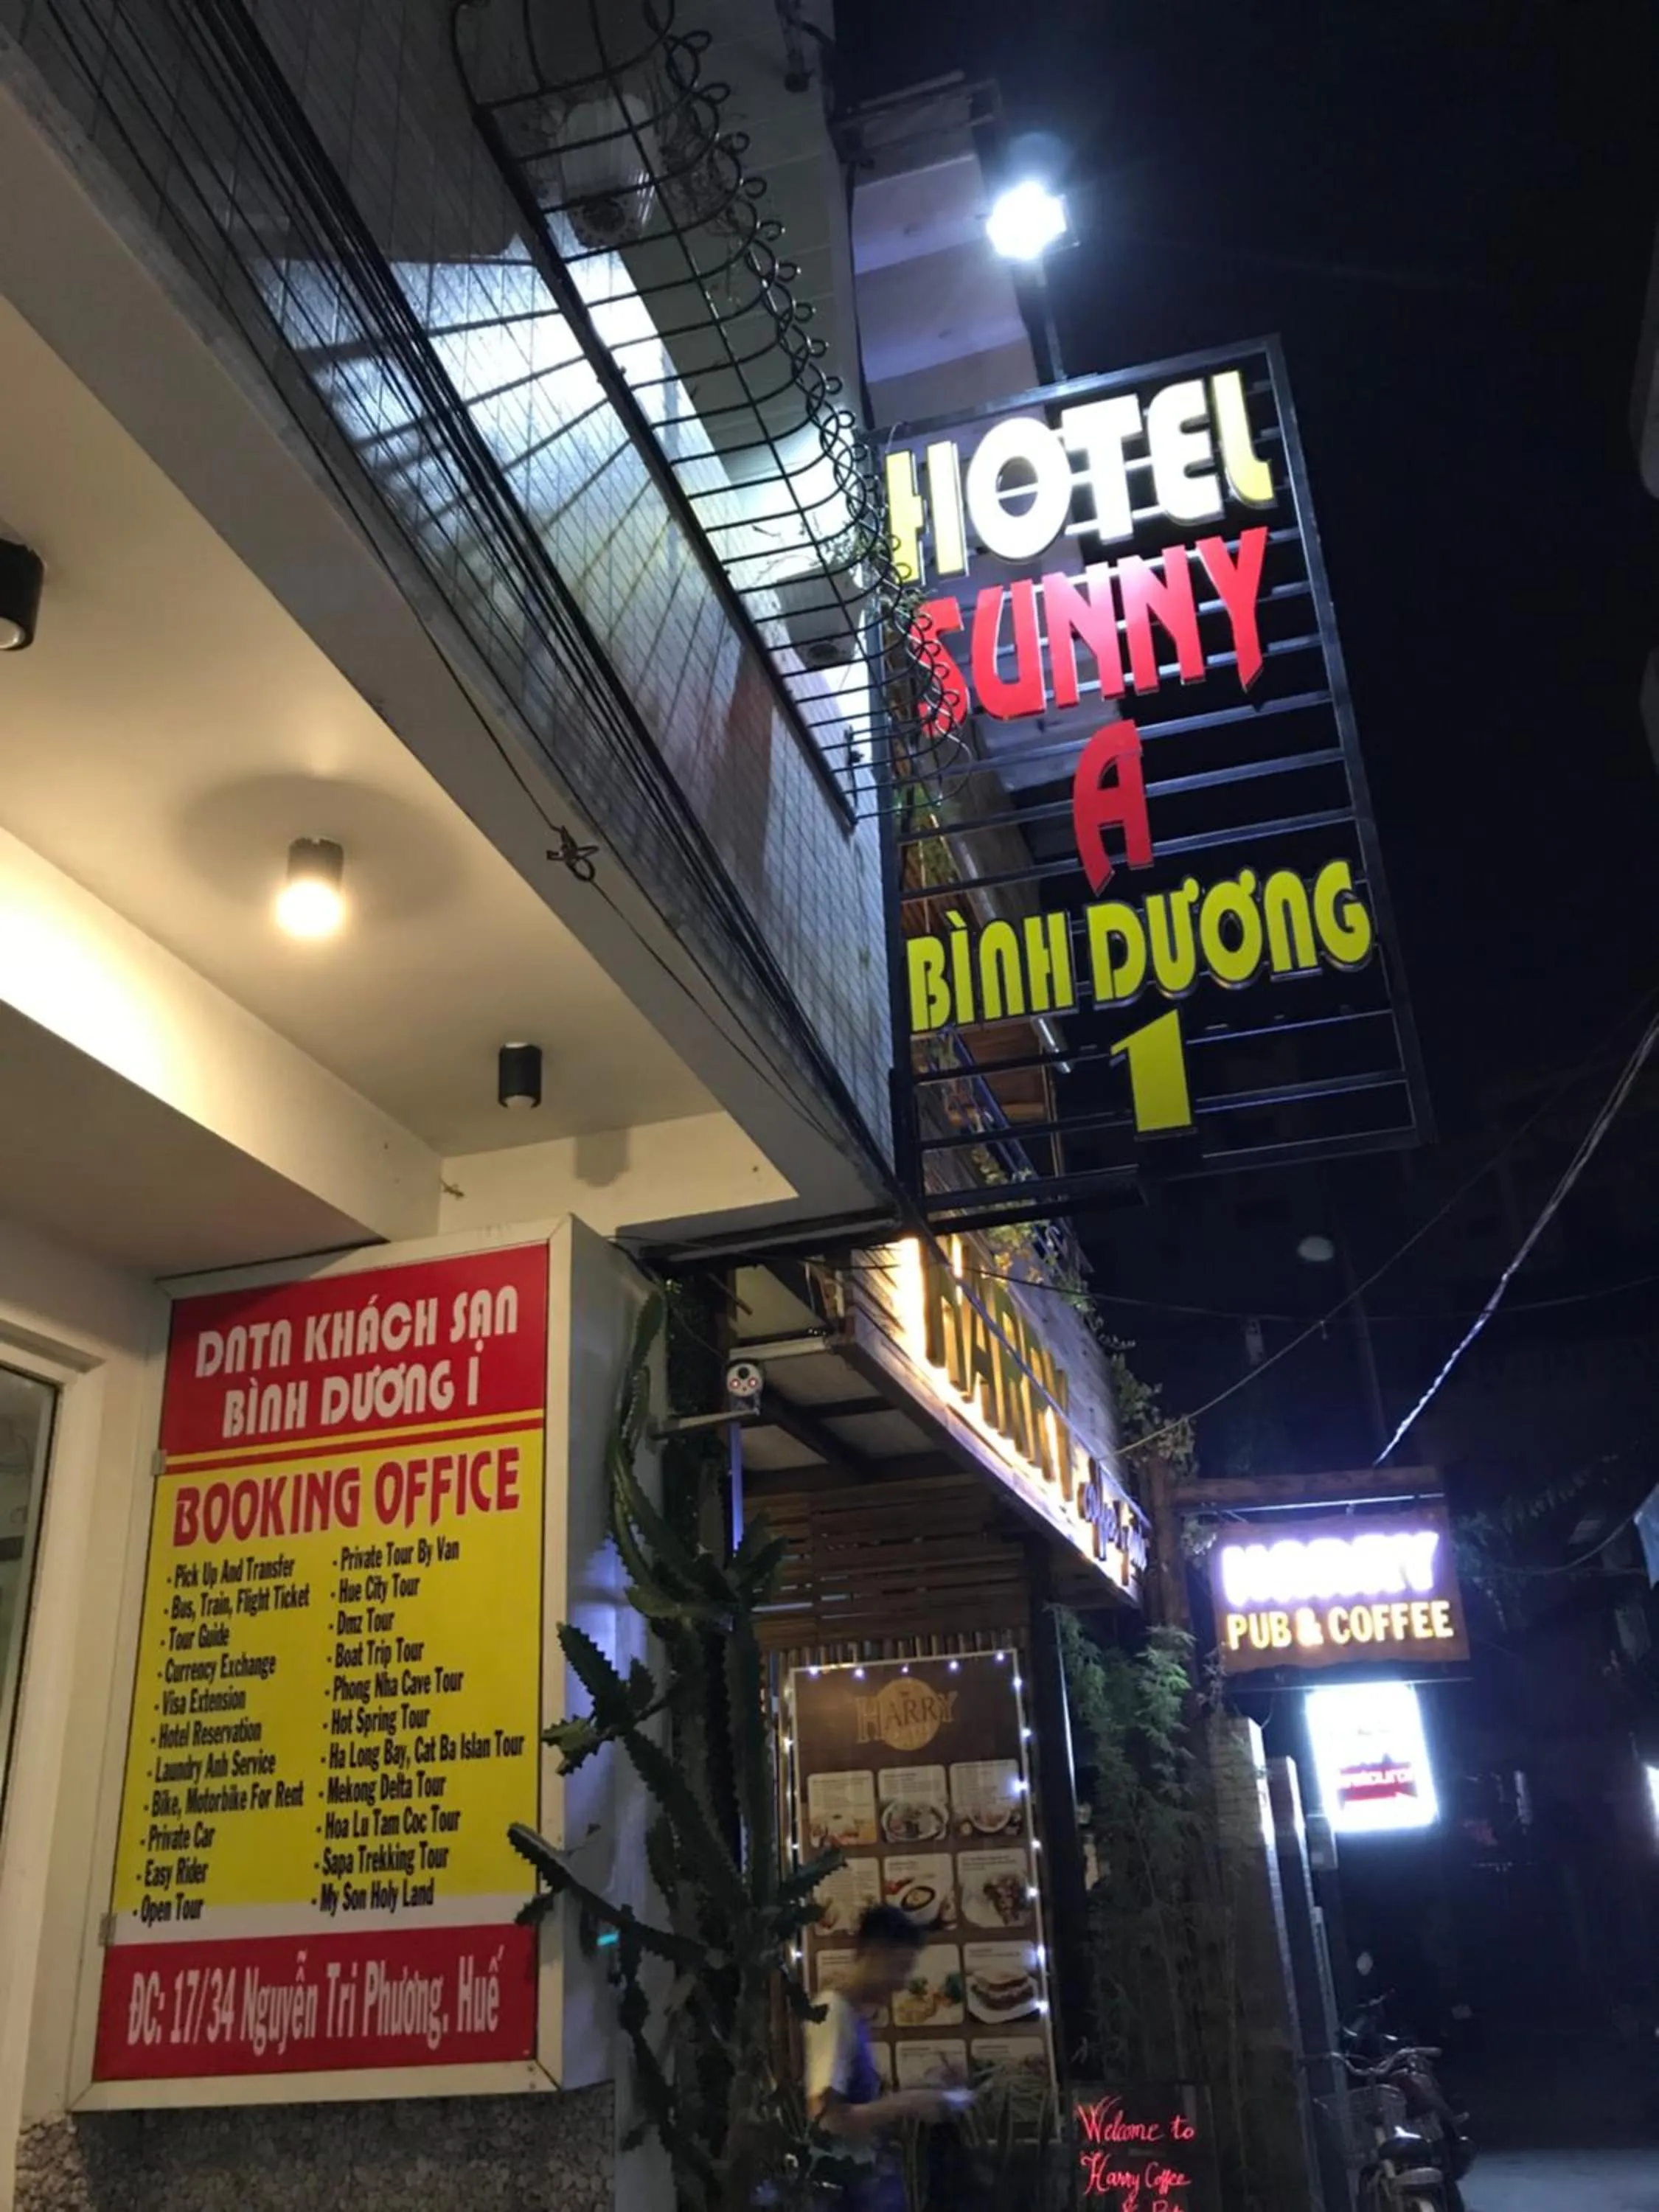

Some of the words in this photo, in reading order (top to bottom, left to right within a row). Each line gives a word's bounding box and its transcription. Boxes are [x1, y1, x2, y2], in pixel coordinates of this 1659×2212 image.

[885, 369, 1276, 585] HOTEL
[910, 526, 1269, 738] SUNNY
[1073, 719, 1153, 897] A
[906, 911, 1078, 1032] BÌNH
[1086, 860, 1373, 1006] DƯƠNG
[1110, 1008, 1194, 1135] 1
[304, 1293, 438, 1363] KHÁCH
[223, 1374, 307, 1439] BÌNH
[320, 1360, 455, 1426] DƯƠNG
[173, 1467, 360, 1547] BOOKING
[375, 1447, 519, 1528] OFFICE
[174, 1562, 198, 1588] Pick
[203, 1560, 218, 1588] Up
[221, 1557, 243, 1583] And
[246, 1553, 295, 1582] Transfer
[341, 1545, 383, 1571] Private
[386, 1541, 414, 1567] Tour
[417, 1537, 434, 1568] By
[437, 1534, 460, 1562] Van
[171, 1594, 196, 1622] Bus,
[201, 1590, 233, 1617] Train,
[236, 1586, 270, 1616] Flight
[274, 1583, 310, 1610] Ticket
[338, 1577, 362, 1604] Hue
[365, 1574, 389, 1604] City
[392, 1572, 421, 1598] Tour
[169, 1626, 195, 1651] Tour
[198, 1622, 230, 1648] Guide
[337, 1610, 363, 1635] Dmz
[366, 1607, 395, 1633] Tour
[1227, 1611, 1292, 1649] PUB
[1327, 1601, 1453, 1644] COFFEE
[164, 1658, 217, 1685] Currency
[220, 1652, 276, 1680] Exchange
[335, 1641, 364, 1669] Boat
[366, 1639, 392, 1668] Trip
[396, 1637, 425, 1663] Tour
[162, 1690, 187, 1716] Visa
[189, 1685, 246, 1714] Extension
[333, 1674, 372, 1704] Phong
[375, 1671, 398, 1699] Nha
[401, 1669, 431, 1696] Cave
[434, 1666, 465, 1693] Tour
[159, 1722, 190, 1749] Hotel
[192, 1717, 262, 1746] Reservation
[330, 1708, 353, 1735] Hot
[356, 1704, 397, 1738] Spring
[400, 1703, 431, 1730] Tour
[855, 1690, 958, 1744] HARRY
[231, 1747, 276, 1777] Service
[329, 1742, 346, 1770] Ha
[349, 1741, 380, 1771] Long
[383, 1737, 411, 1770] Bay,
[414, 1734, 436, 1763] Cat
[439, 1733, 457, 1761] Ba
[460, 1731, 491, 1759] Islan
[494, 1729, 525, 1756] Tour
[151, 1789, 182, 1820] Bike,
[184, 1784, 248, 1815] Motorbike
[249, 1781, 271, 1809] For
[274, 1780, 304, 1808] Rent
[327, 1775, 377, 1806] Mekong
[380, 1771, 413, 1801] Delta
[416, 1770, 447, 1798] Tour
[147, 1823, 192, 1852] Private
[193, 1820, 216, 1848] Car
[325, 1811, 349, 1840] Hoa
[353, 1809, 369, 1838] Lu
[373, 1808, 400, 1837] Tam
[403, 1806, 428, 1834] Coc
[431, 1804, 462, 1832] Tour
[144, 1859, 173, 1891] Easy
[175, 1856, 209, 1885] Rider
[322, 1846, 354, 1880] Sapa
[358, 1842, 415, 1876] Trekking
[419, 1840, 449, 1870] Tour
[141, 1893, 172, 1928] Open
[175, 1892, 204, 1920] Tour
[320, 1882, 338, 1917] My
[342, 1881, 366, 1911] Son
[370, 1879, 399, 1914] Holy
[402, 1877, 434, 1907] Land
[170, 1966, 237, 2045] 17/34
[240, 1950, 319, 2056] Nguyễn
[456, 1944, 505, 2033] Huế
[1077, 2096, 1165, 2144] Welcome
[1171, 2115, 1195, 2139] to
